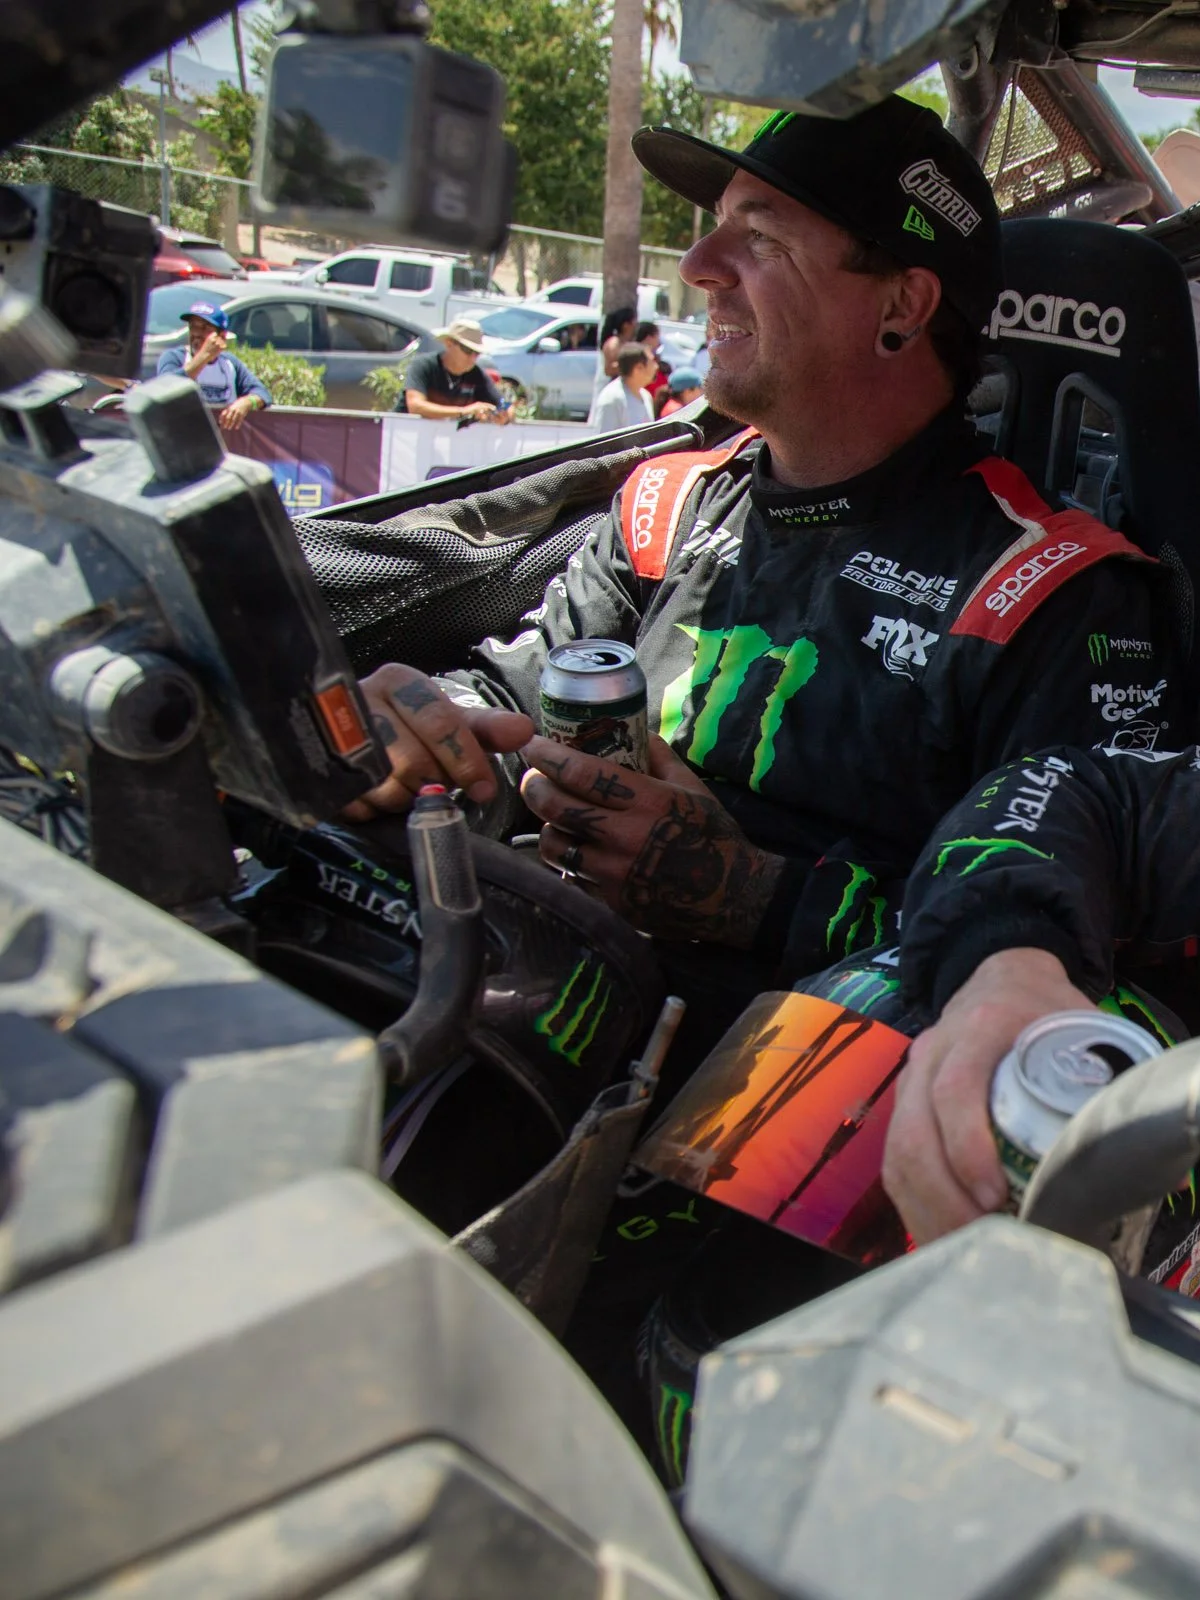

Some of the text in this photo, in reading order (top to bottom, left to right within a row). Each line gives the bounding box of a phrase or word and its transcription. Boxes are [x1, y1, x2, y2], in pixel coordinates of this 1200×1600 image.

[900, 160, 981, 236] CURRIE
[982, 290, 1126, 357] parco
[632, 468, 669, 552] sparco
[768, 498, 850, 518] MONSTER
[785, 514, 838, 523] ENERGY
[841, 568, 948, 610] FACTORY RAING
[986, 542, 1088, 617] sparco
[861, 615, 940, 681] FOX
[1110, 638, 1153, 653] MONST
[1119, 652, 1152, 660] ENERG
[1101, 694, 1161, 722] Ger
[993, 756, 1074, 832] NSTER
[319, 862, 424, 938] NSTER
